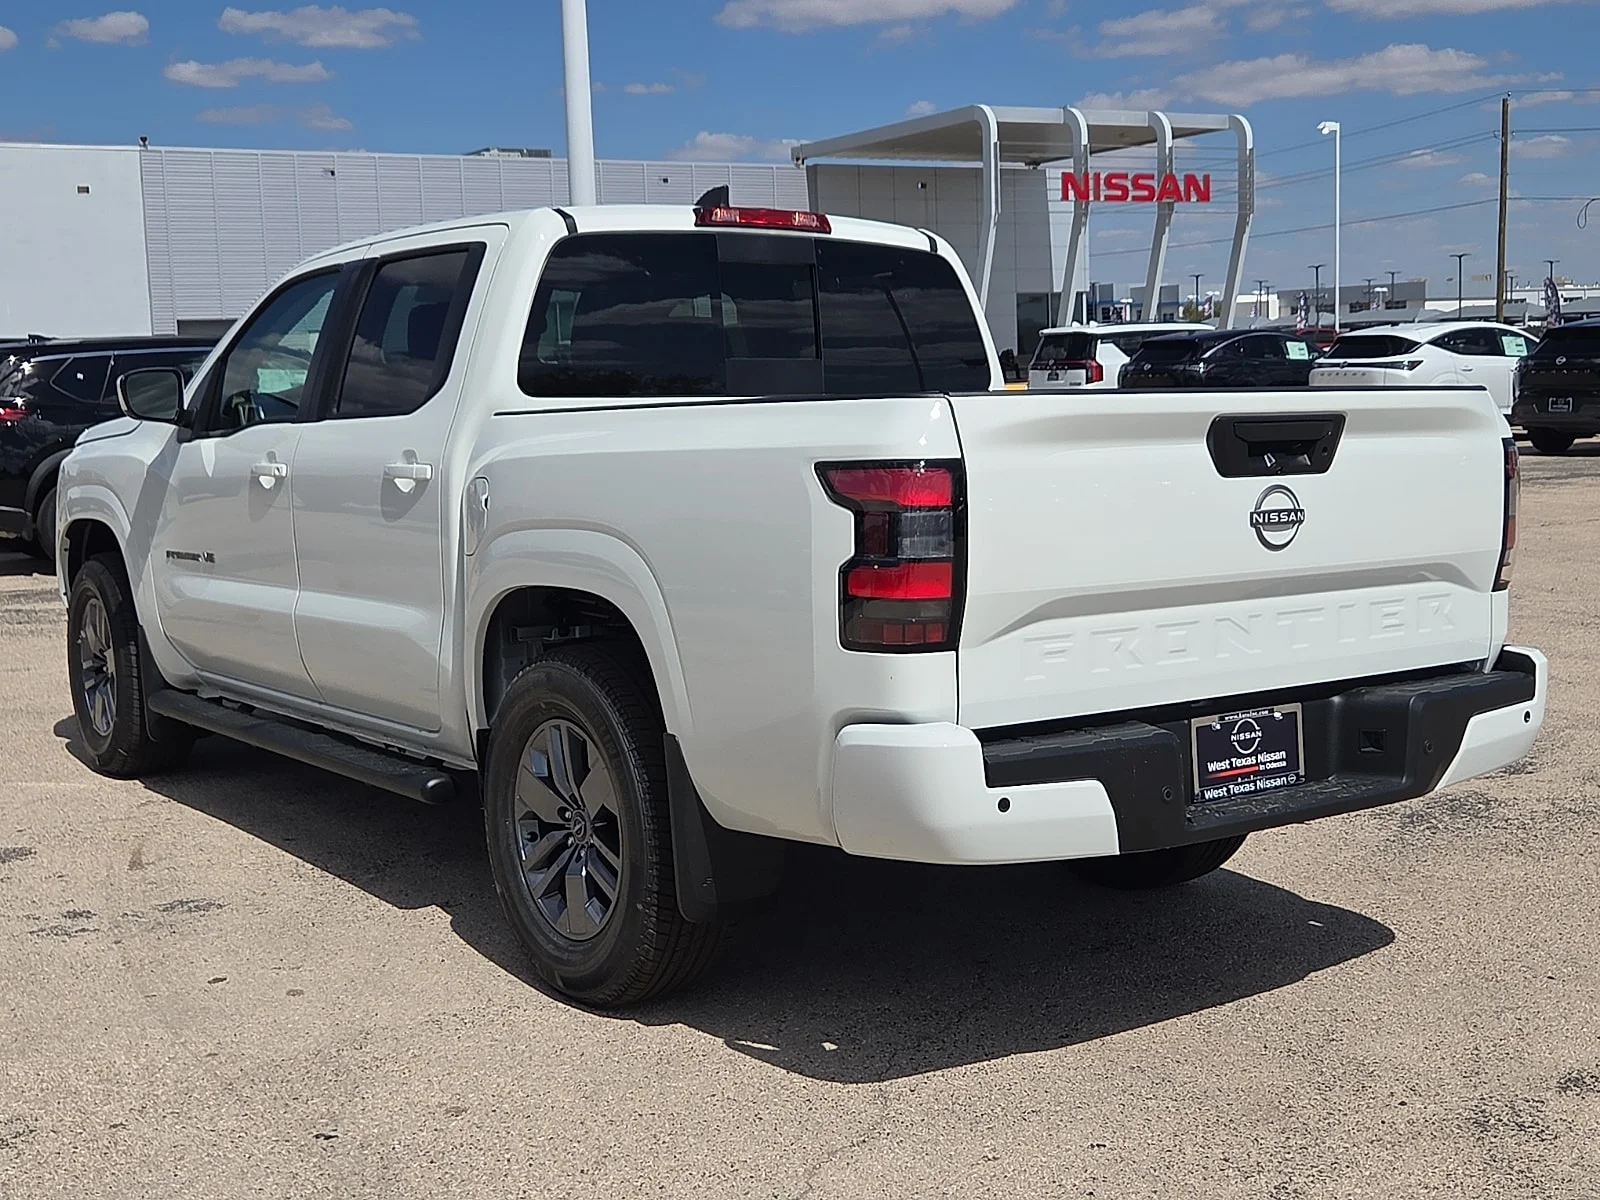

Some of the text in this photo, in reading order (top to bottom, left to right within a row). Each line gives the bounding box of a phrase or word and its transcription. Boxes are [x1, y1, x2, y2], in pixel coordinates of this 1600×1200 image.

[1061, 172, 1210, 202] NISSAN
[1252, 511, 1304, 523] NISSAN
[1023, 593, 1455, 681] FRONTIER
[1231, 730, 1262, 741] NISSAN
[1207, 750, 1286, 772] West Texas Nissan
[1204, 787, 1227, 800] West
[1228, 783, 1255, 794] Texas
[1256, 777, 1287, 789] Nissan
